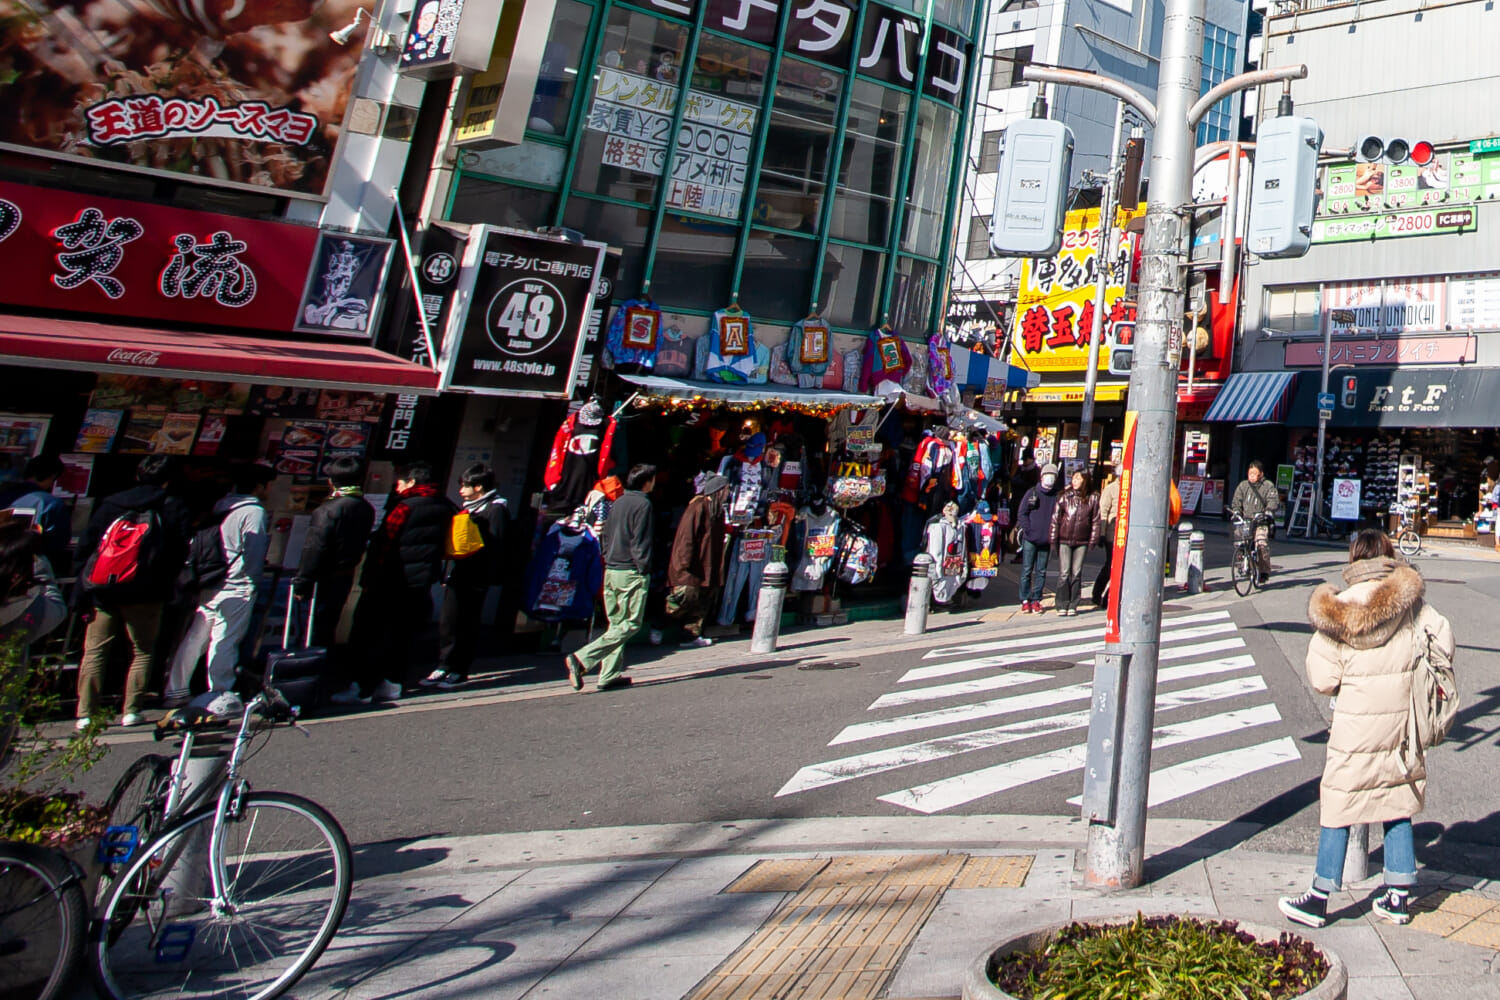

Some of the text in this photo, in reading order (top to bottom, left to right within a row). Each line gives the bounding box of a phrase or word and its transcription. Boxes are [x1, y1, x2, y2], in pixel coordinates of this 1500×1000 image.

[90, 97, 315, 144] 王道のソースマヨ
[484, 251, 593, 279] 電子タバコ専門店
[524, 283, 544, 294] VAPE
[498, 292, 555, 340] 48
[585, 308, 603, 342] VAPE
[507, 338, 532, 349] Japan
[473, 358, 555, 377] www.48style.jp
[575, 353, 594, 388] VAPE
[1368, 404, 1440, 412] Face to Face
